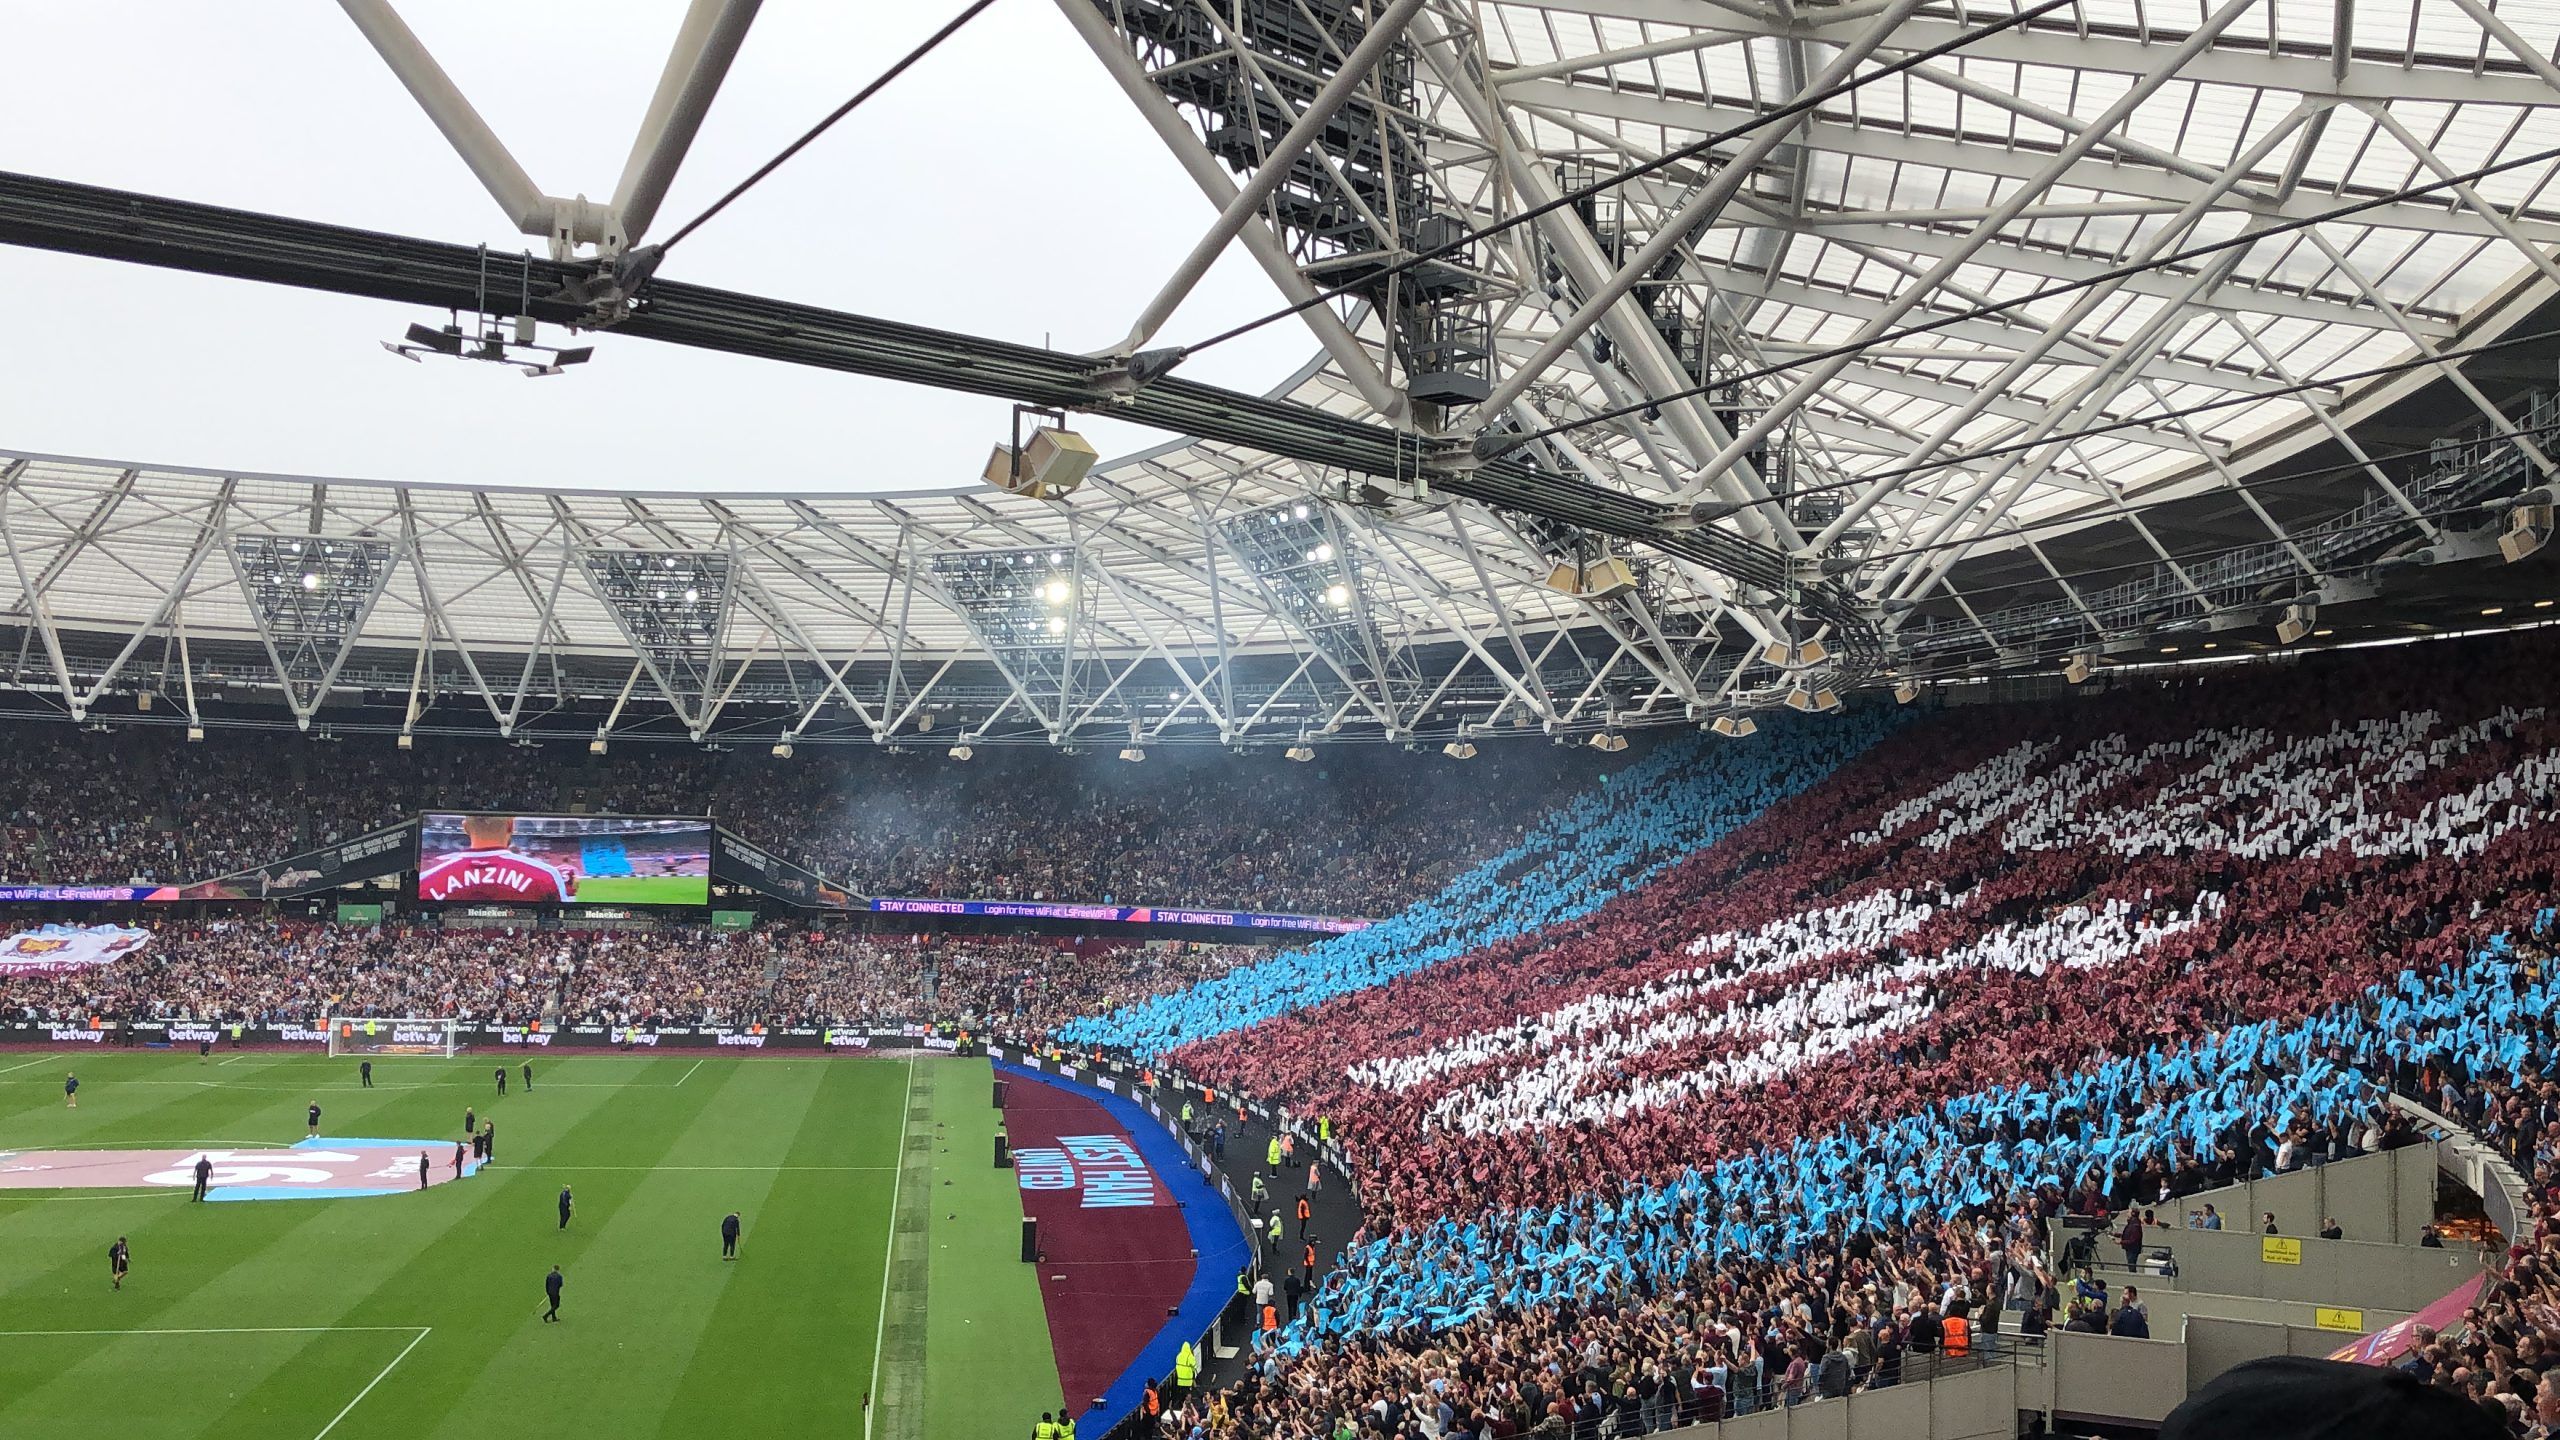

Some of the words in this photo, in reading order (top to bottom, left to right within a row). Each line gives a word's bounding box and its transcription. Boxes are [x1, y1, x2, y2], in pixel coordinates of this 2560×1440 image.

[430, 867, 533, 900] LANZINI
[14, 889, 37, 899] WiFi
[38, 889, 50, 899] at
[468, 908, 507, 917] Heineken
[880, 901, 904, 911] STAY
[906, 902, 964, 913] CONNECTED
[984, 905, 1005, 915] Login
[1006, 905, 1017, 915] for
[1018, 906, 1034, 915] free
[1036, 907, 1052, 916] WiFi
[1053, 908, 1060, 916] at
[585, 910, 624, 919] Heineken
[1157, 912, 1179, 922] STAY
[1181, 913, 1233, 925] CONNECTED
[1251, 917, 1270, 927] Login
[1271, 917, 1281, 927] for
[1282, 918, 1296, 928] free
[1297, 919, 1312, 929] WiFi
[1312, 921, 1320, 930] at
[52, 1029, 104, 1042] betway
[168, 1028, 219, 1043] betway
[281, 1029, 330, 1043] betway
[718, 1034, 765, 1047] betway
[924, 1037, 957, 1051] betway
[1023, 1053, 1041, 1071] betway
[1056, 1135, 1145, 1168] WEST
[143, 1151, 361, 1186] 16
[1012, 1148, 1076, 1189] UNITED
[1080, 1171, 1154, 1208] HAM
